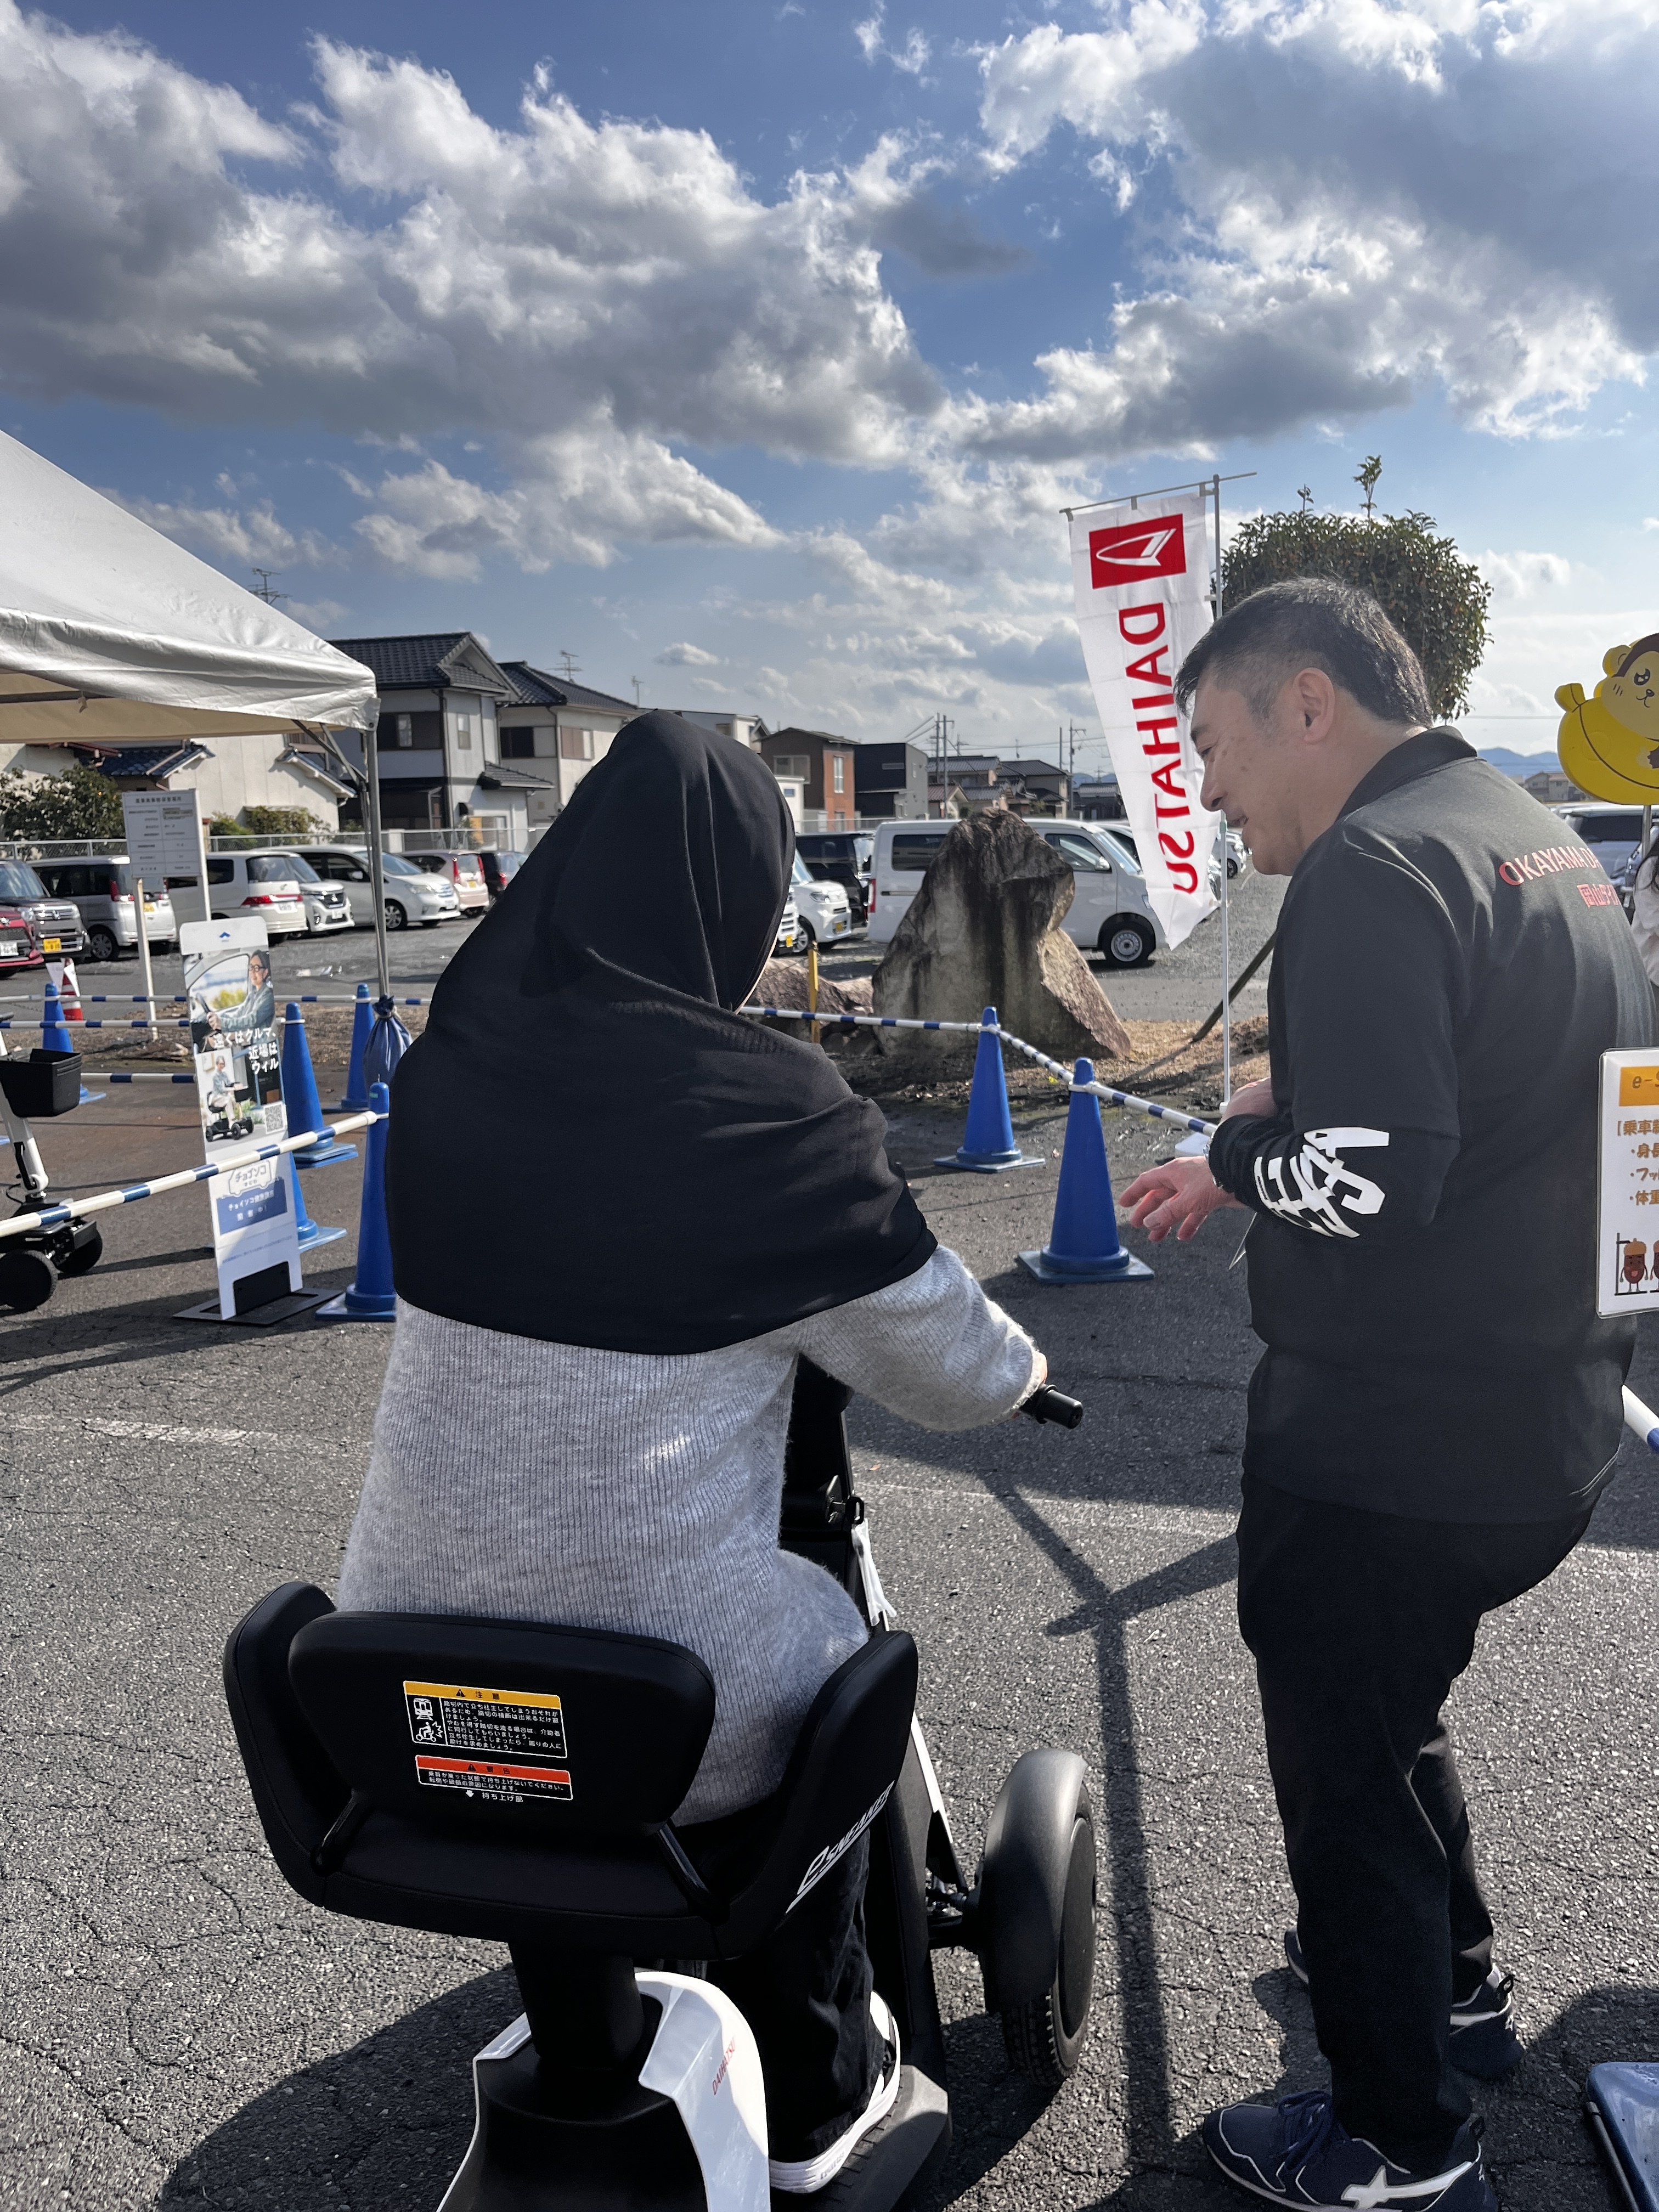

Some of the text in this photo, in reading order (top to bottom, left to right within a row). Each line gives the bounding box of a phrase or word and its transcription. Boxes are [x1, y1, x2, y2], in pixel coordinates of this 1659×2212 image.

[1499, 846, 1589, 885] OKAYAMA
[248, 1042, 278, 1060] 近場は
[252, 1058, 279, 1075] ウィル
